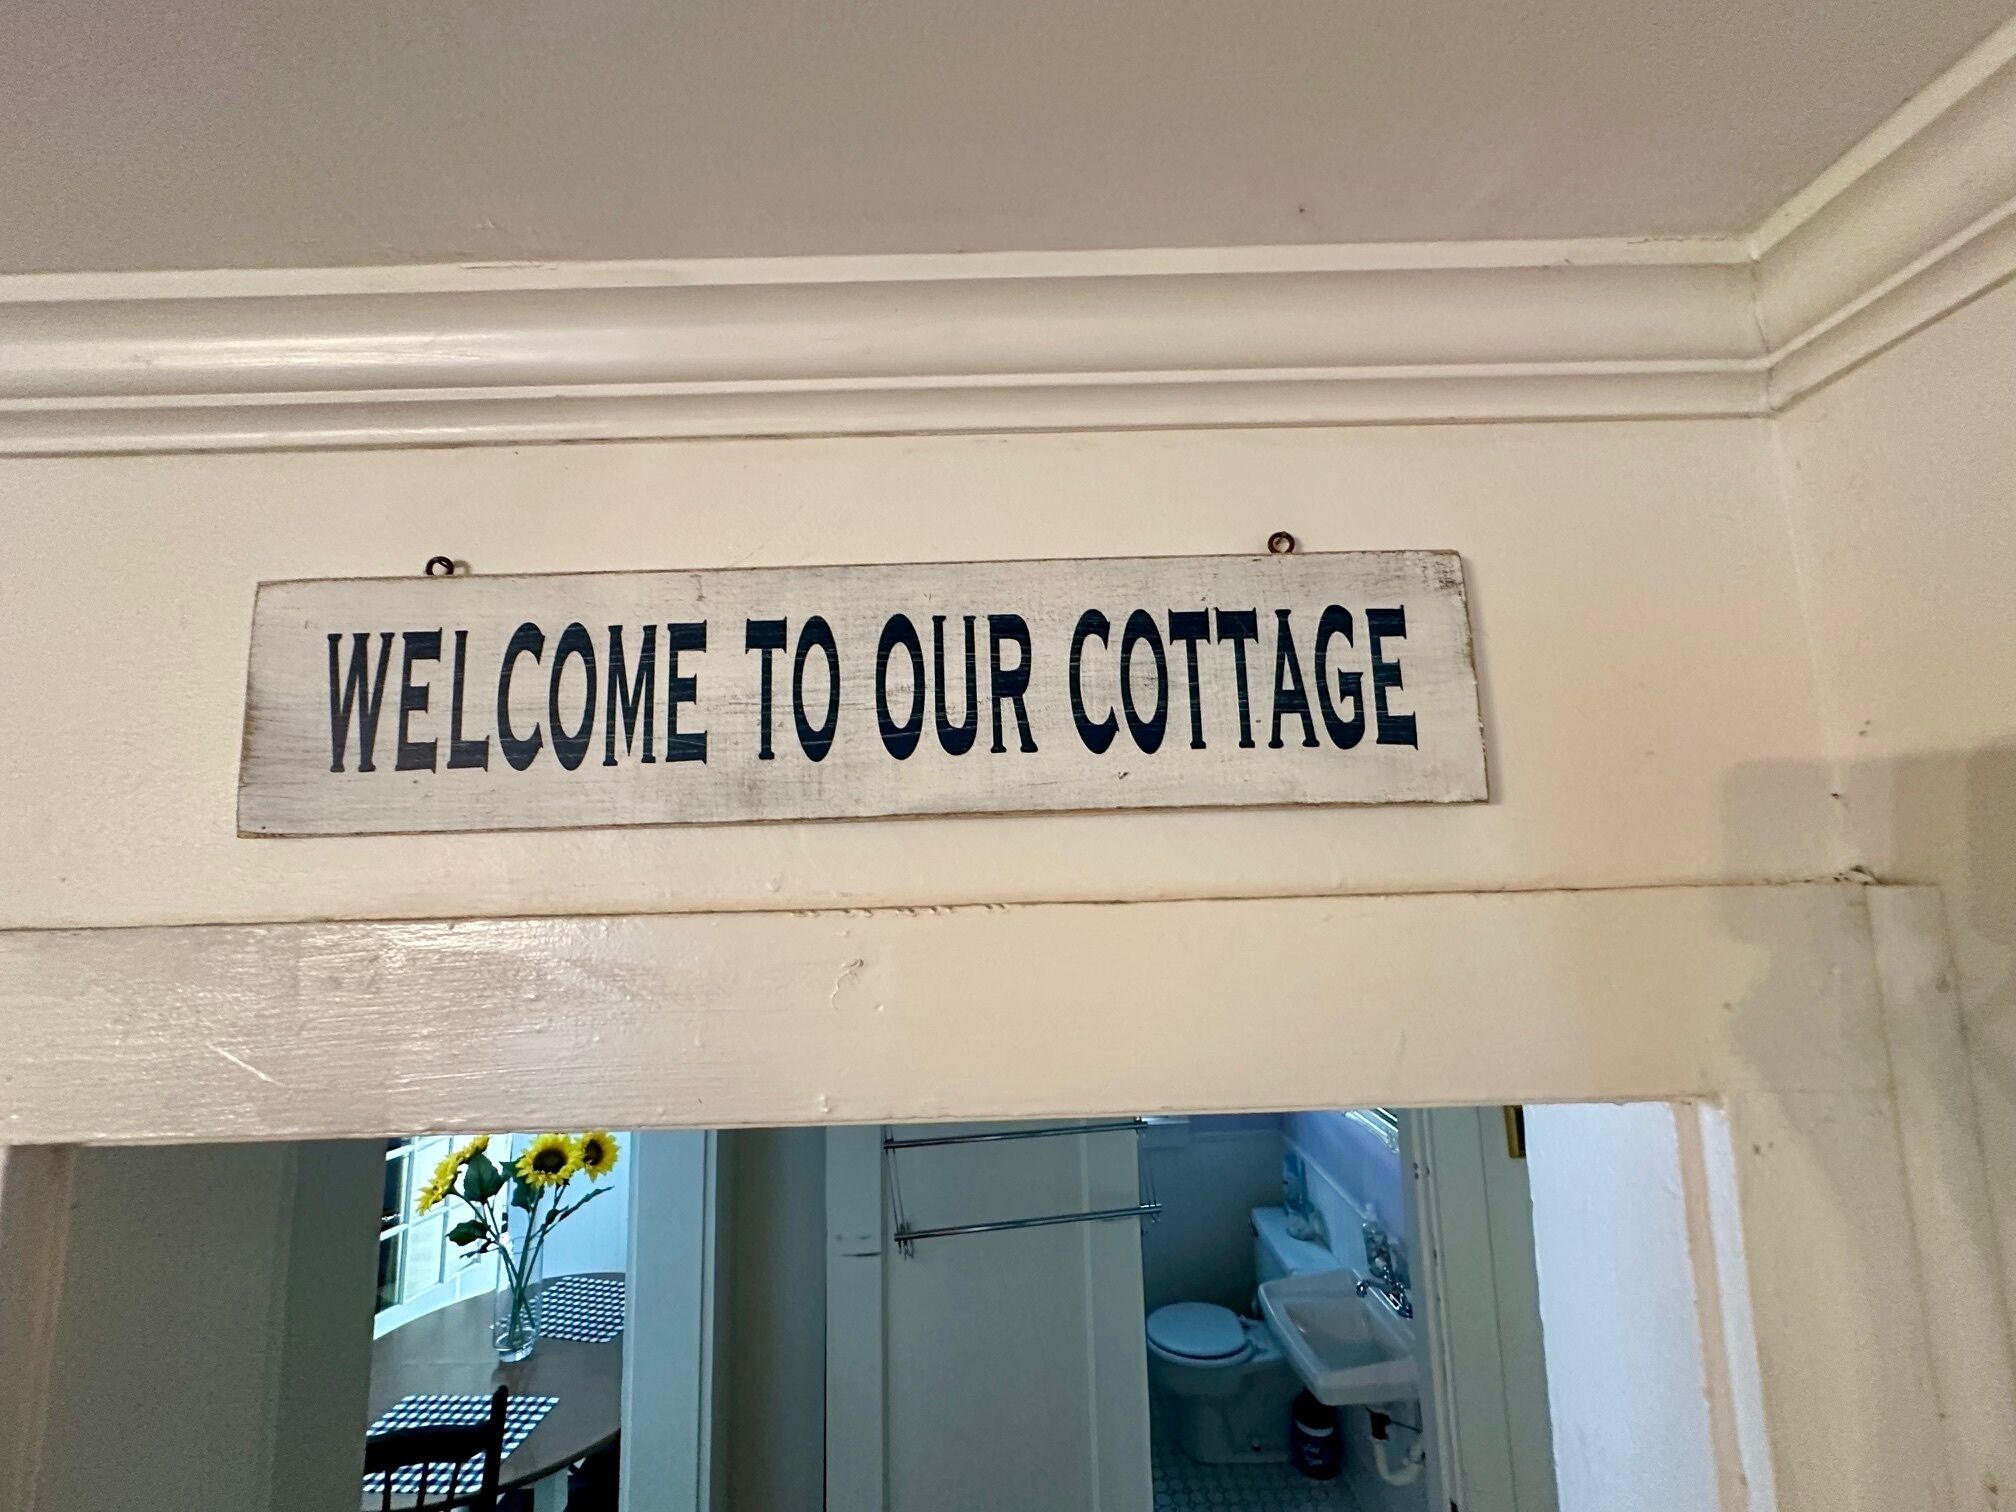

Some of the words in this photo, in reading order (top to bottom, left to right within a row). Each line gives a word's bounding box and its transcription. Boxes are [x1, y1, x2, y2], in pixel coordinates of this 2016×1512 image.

[328, 620, 708, 774] WELCOME
[745, 615, 841, 763] TO
[876, 613, 1038, 761] OUR
[1069, 604, 1419, 755] COTTAGE
